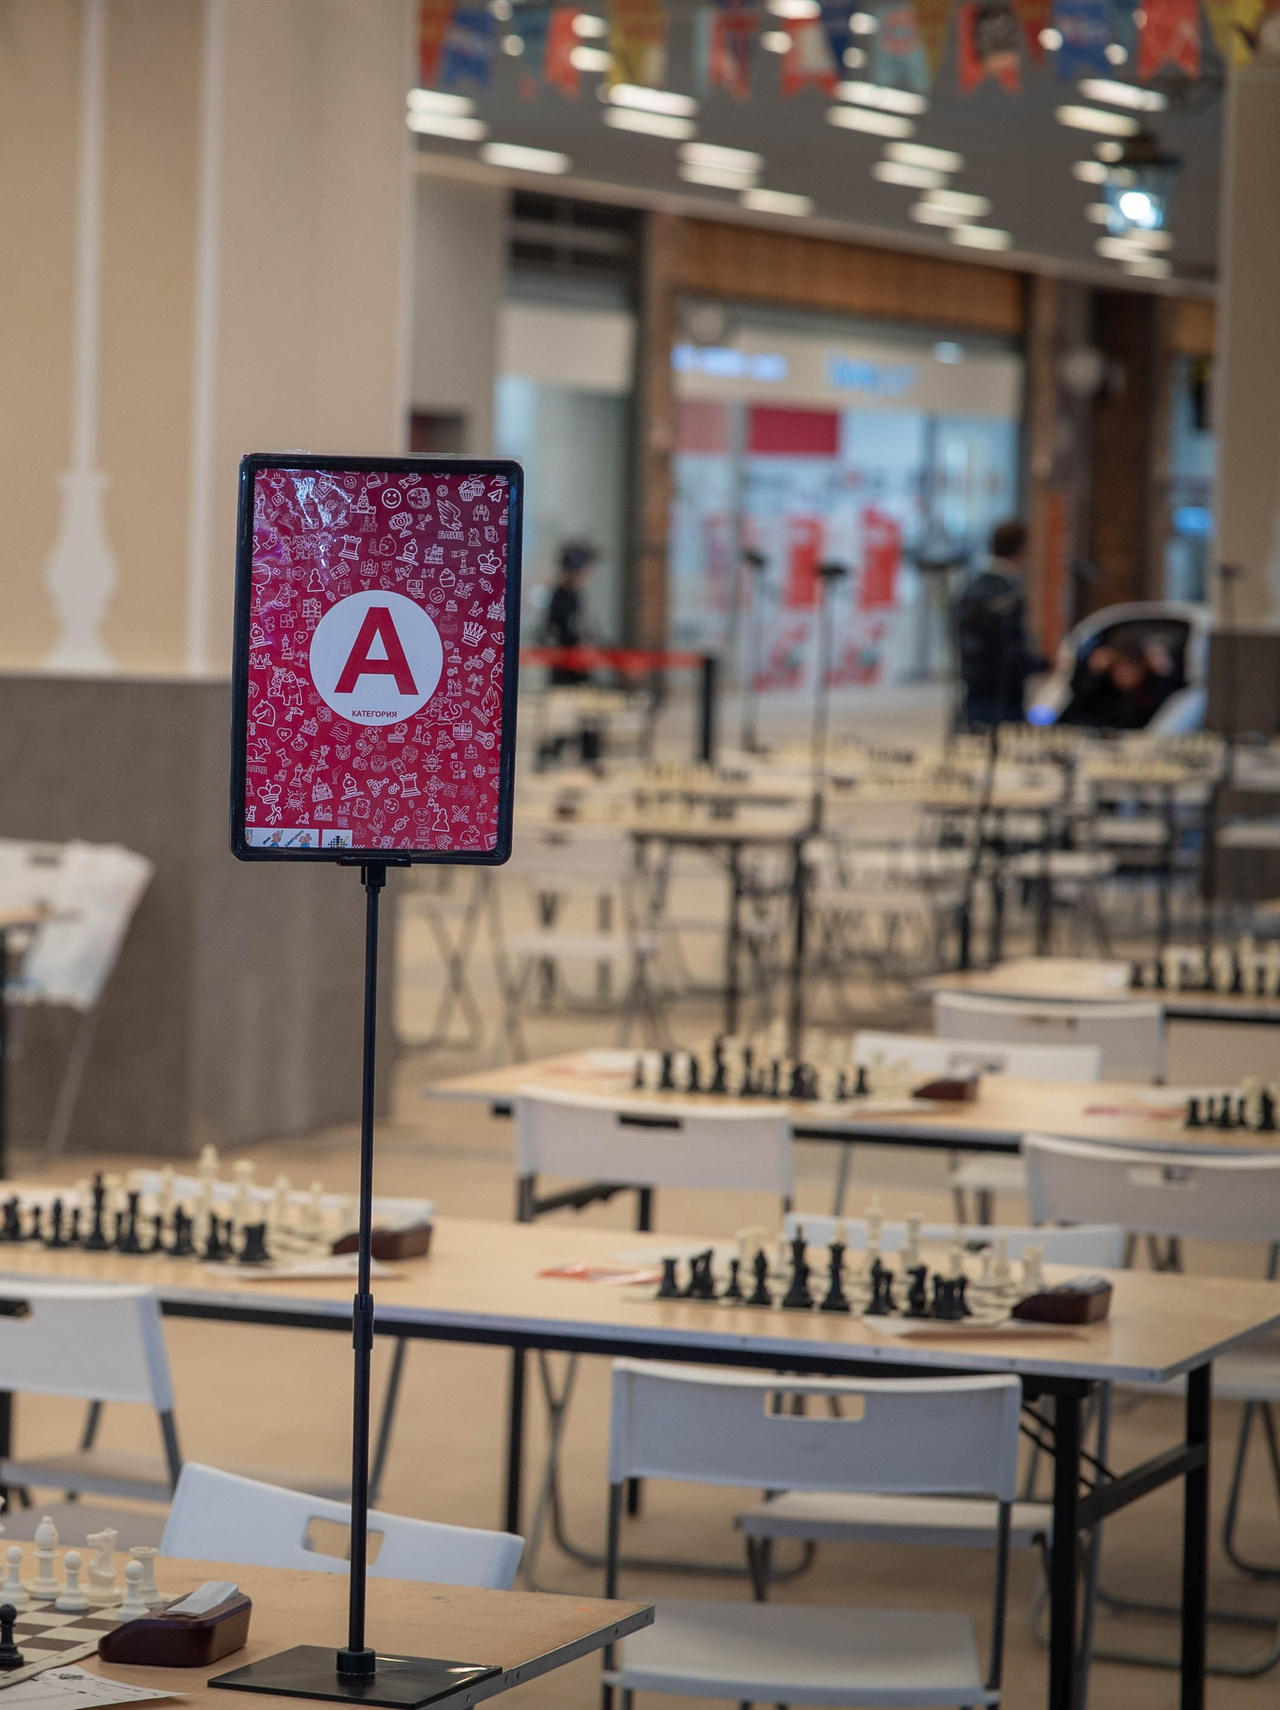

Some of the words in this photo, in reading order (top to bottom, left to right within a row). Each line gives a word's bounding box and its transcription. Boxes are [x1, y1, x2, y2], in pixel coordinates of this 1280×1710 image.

[438, 530, 464, 541] БЛИЦ
[334, 607, 419, 695] А
[352, 710, 397, 718] КАТЕГОРИЯ
